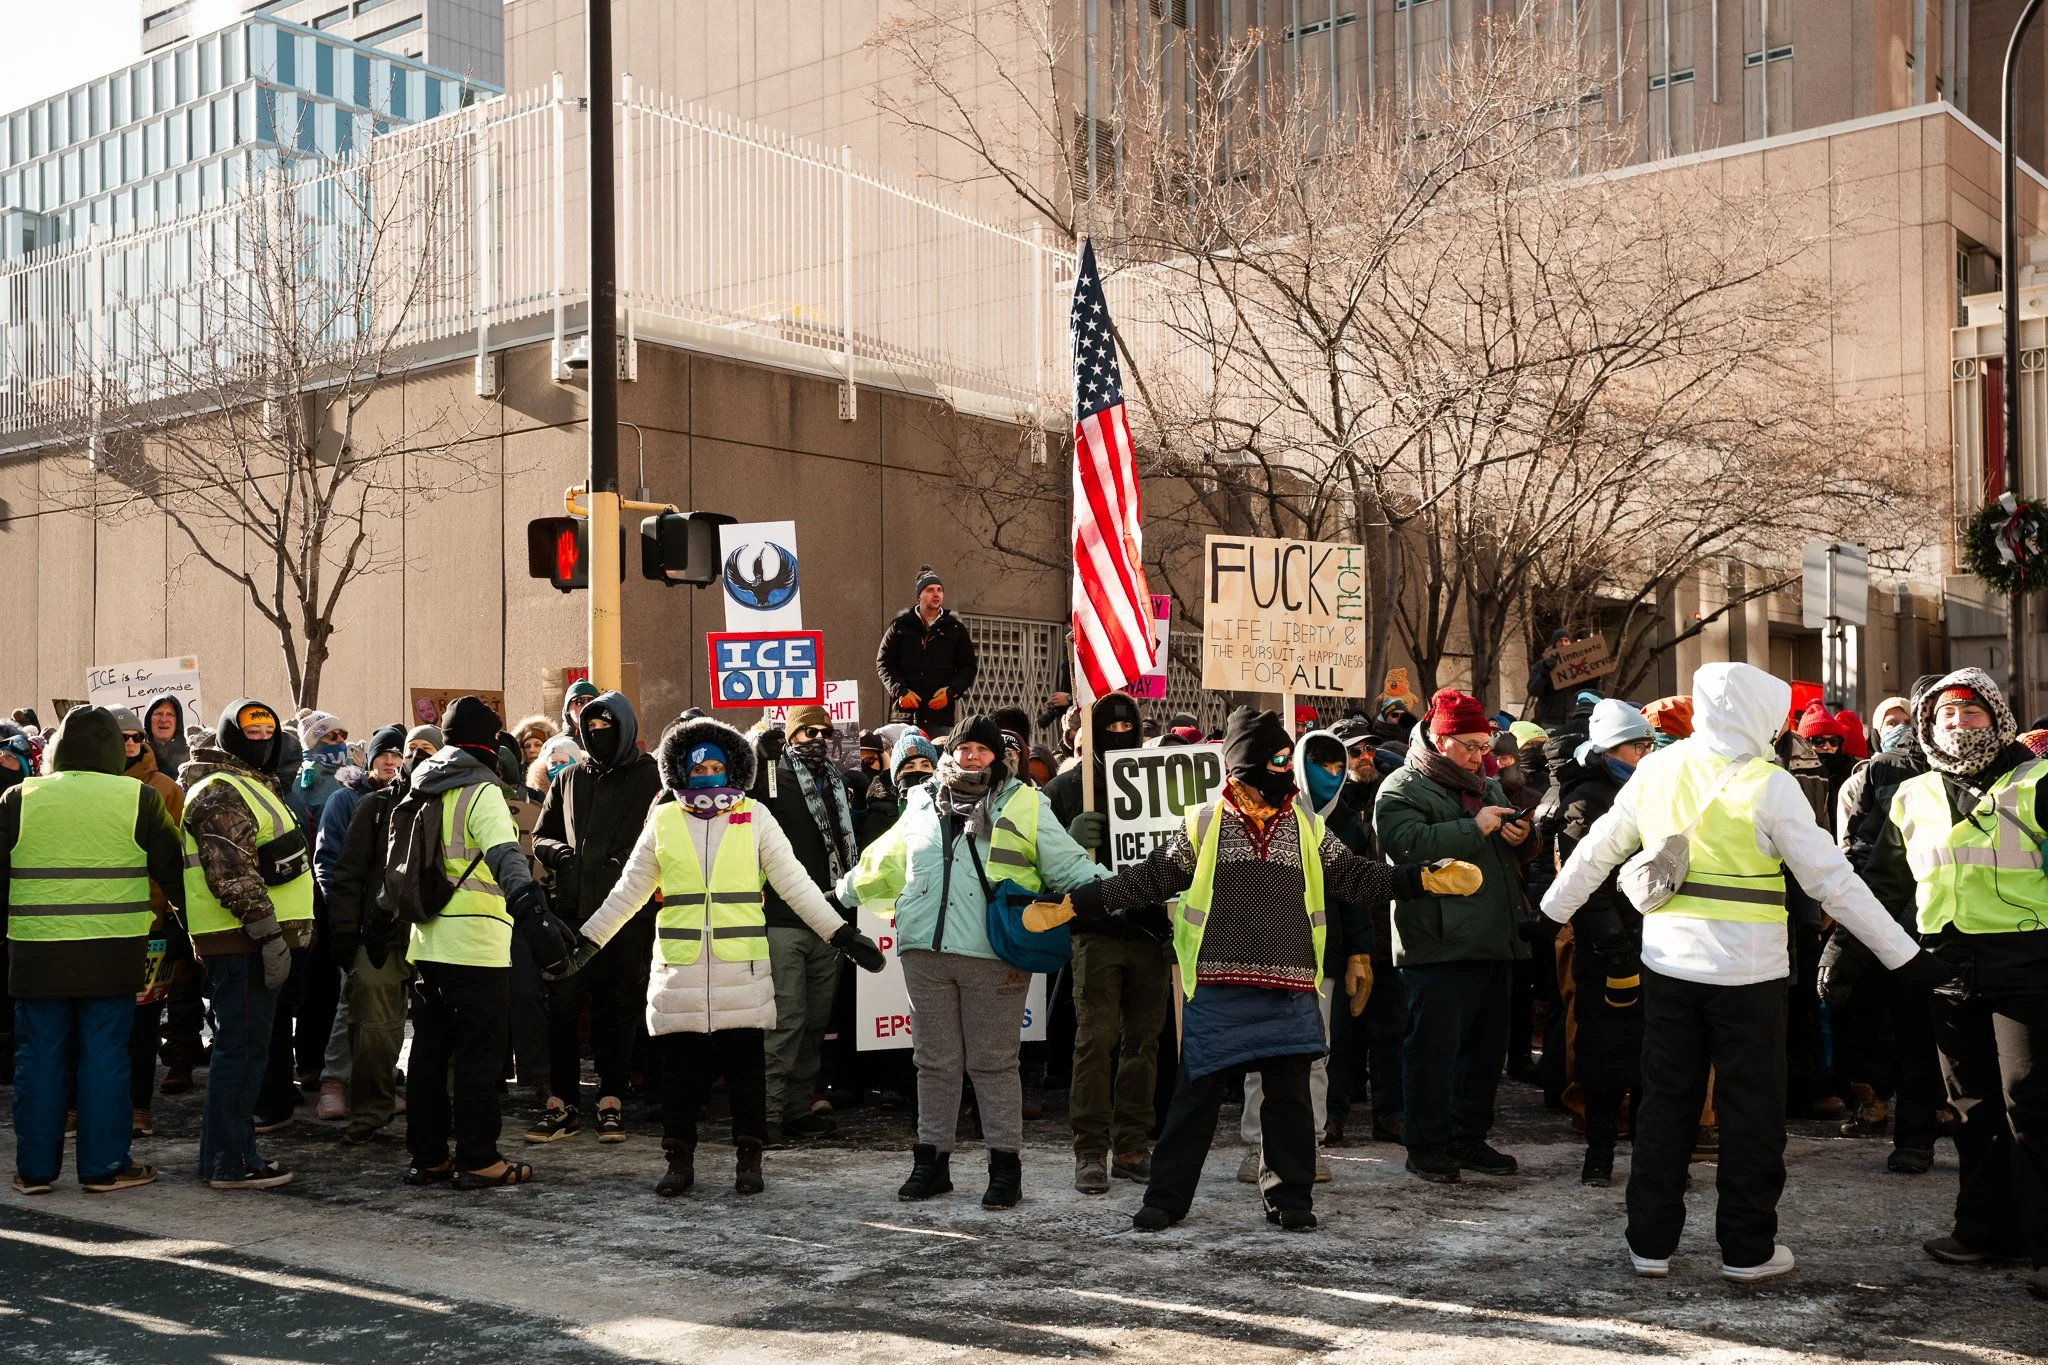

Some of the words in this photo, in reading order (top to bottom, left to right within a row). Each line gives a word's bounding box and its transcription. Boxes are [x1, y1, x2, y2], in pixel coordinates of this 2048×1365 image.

[1211, 542, 1333, 616] FUCK
[1336, 547, 1362, 620] ICE
[1211, 619, 1265, 643] LIFE,
[1270, 620, 1340, 648] LIBERTY,
[1344, 626, 1356, 645] &
[723, 639, 812, 669] ICE
[1211, 644, 1234, 659] THE
[1242, 644, 1296, 663] PURSUIT
[1308, 649, 1364, 669] HAPPINESS
[1555, 643, 1602, 665] Minnesota
[88, 668, 116, 693] ICE
[121, 673, 130, 682] is
[135, 668, 153, 681] for
[127, 682, 194, 698] Lemonade
[722, 670, 810, 701] OUT
[1119, 676, 1153, 697] WAY
[1241, 661, 1286, 686] FOR
[1290, 663, 1344, 692] ALL
[825, 701, 856, 721] HIT
[1112, 752, 1221, 820] STOP
[1115, 831, 1147, 861] ICE
